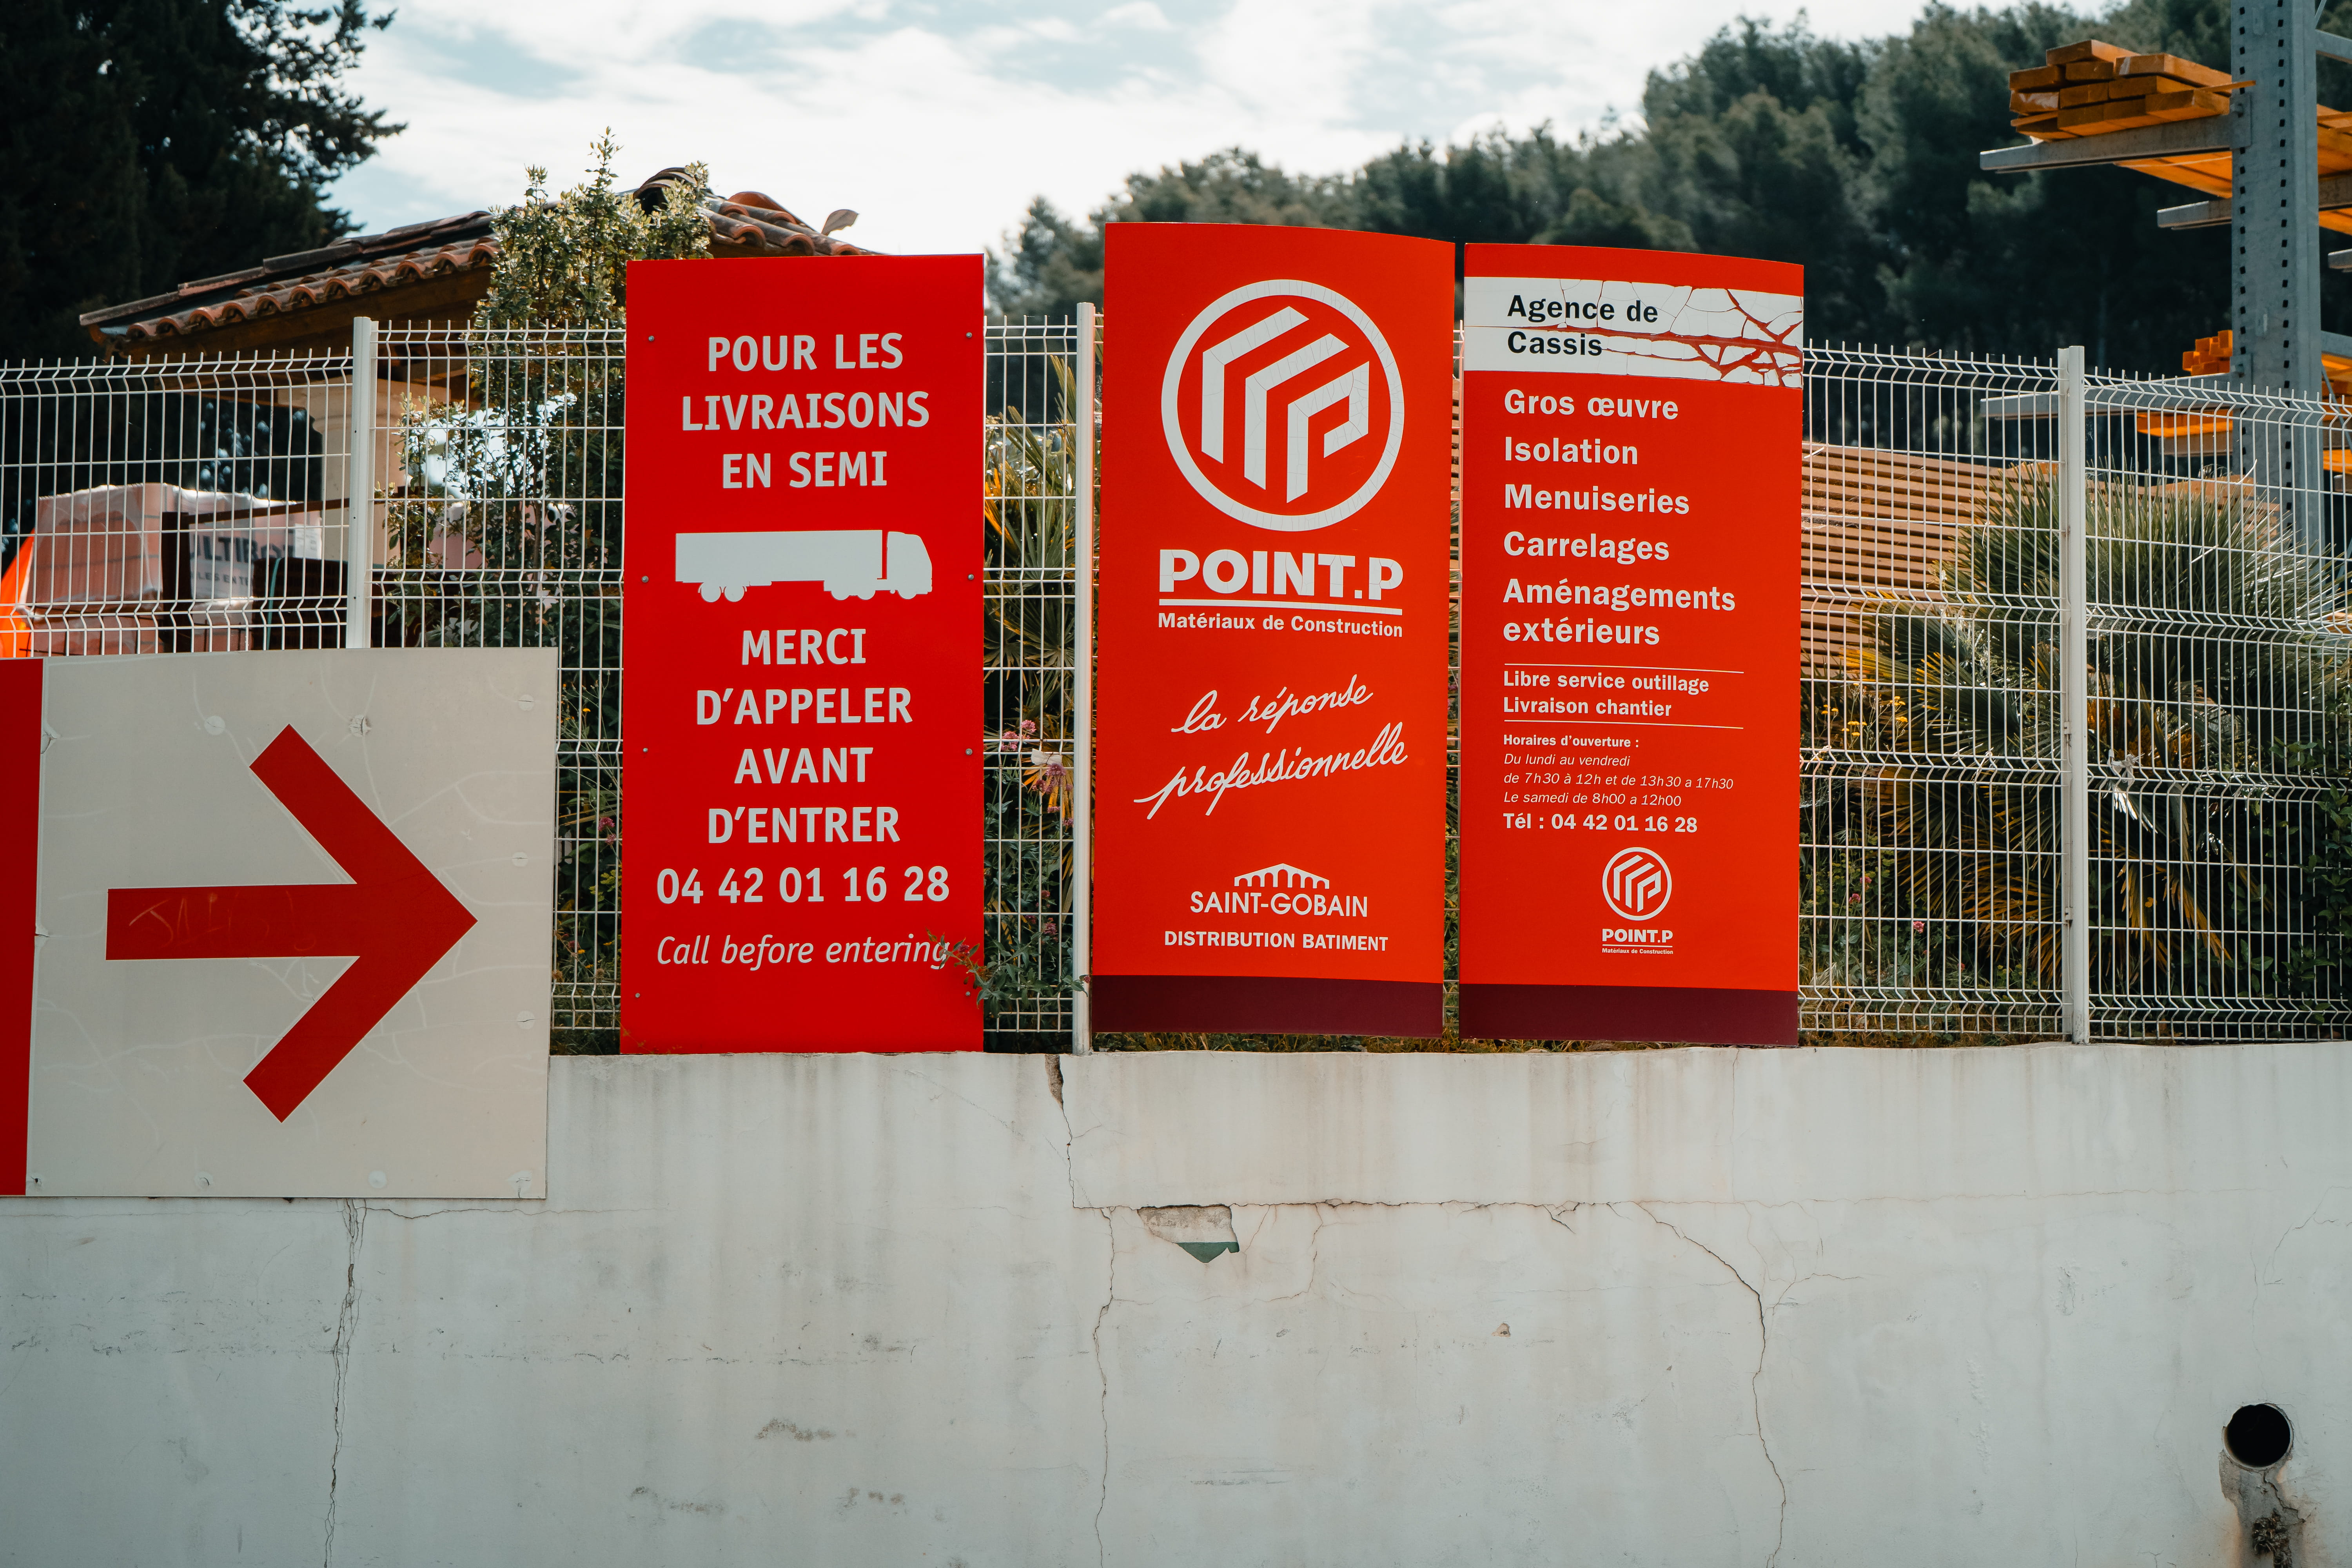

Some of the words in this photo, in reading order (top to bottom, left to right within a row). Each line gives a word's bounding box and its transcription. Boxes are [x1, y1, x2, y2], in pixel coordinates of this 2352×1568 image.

[1507, 294, 1615, 322] Agence
[1626, 299, 1658, 323] de
[708, 334, 817, 372] POUR
[835, 332, 903, 369] LES
[1507, 331, 1603, 356] Cassis
[682, 390, 929, 431] LIVRAISONS
[1504, 388, 1575, 415] Gros
[1587, 397, 1678, 420] œuvre
[1505, 436, 1637, 465] Isolation
[722, 452, 771, 488] EN
[789, 451, 887, 488] SEMI
[1504, 483, 1689, 514] Menuiseries
[1503, 530, 1669, 564] Carrelages
[1159, 548, 1403, 600] POINT.P
[1503, 577, 1735, 612] Aménagements
[1158, 612, 1255, 629] Matériaux
[1262, 614, 1284, 630] de
[1290, 615, 1403, 637] Construction
[1503, 616, 1660, 645] extérieurs
[742, 628, 866, 665] MERCI
[1504, 670, 1550, 687] Libre
[1557, 671, 1625, 689] service
[1632, 674, 1709, 695] outillage
[697, 687, 913, 725] D'APPELER
[1171, 689, 1227, 734] la
[1237, 673, 1374, 734] réponse
[1503, 696, 1588, 713] Livraison
[1595, 699, 1671, 716] chantier
[1503, 734, 1556, 746] Horaires
[1560, 735, 1631, 748] d'ouverture
[734, 747, 873, 784] AVANT
[1133, 721, 1408, 820] professionnelle
[1504, 753, 1521, 764] Du
[1525, 753, 1556, 765] lundi
[1559, 756, 1575, 765] au
[1579, 755, 1630, 766] vendredi
[1503, 772, 1519, 783] de
[1525, 772, 1560, 784] 7h30
[1563, 773, 1571, 784] à
[1575, 773, 1601, 784] 12h
[1605, 775, 1617, 785] et
[1621, 774, 1636, 786] de
[1640, 775, 1681, 787] 13h30
[1684, 779, 1692, 788] a
[1695, 777, 1733, 789] 17h30
[1503, 791, 1519, 802] Le
[1523, 792, 1569, 803] samedi
[1572, 792, 1588, 804] de
[1592, 792, 1626, 804] 8h00
[1629, 796, 1637, 805] a
[1641, 794, 1681, 806] 12h00
[708, 806, 900, 843] D'ENTRER
[1503, 812, 1531, 829] Tél
[1551, 813, 1576, 829] 04
[1583, 814, 1607, 830] 42
[1614, 814, 1639, 831] 01
[1644, 815, 1668, 832] 16
[1674, 816, 1697, 833] 28
[657, 867, 704, 904] 04
[718, 867, 763, 904] 42
[779, 867, 824, 903] 01
[842, 866, 887, 902] 16
[904, 865, 949, 902] 28
[1190, 891, 1367, 917] SAINT-GOBAIN
[1164, 930, 1295, 948] DISTRIBUTION
[1302, 933, 1388, 951] BATIMENT
[1602, 928, 1673, 943] POINT.P
[657, 935, 710, 964] Call
[721, 934, 814, 971] before
[826, 933, 951, 969] entering
